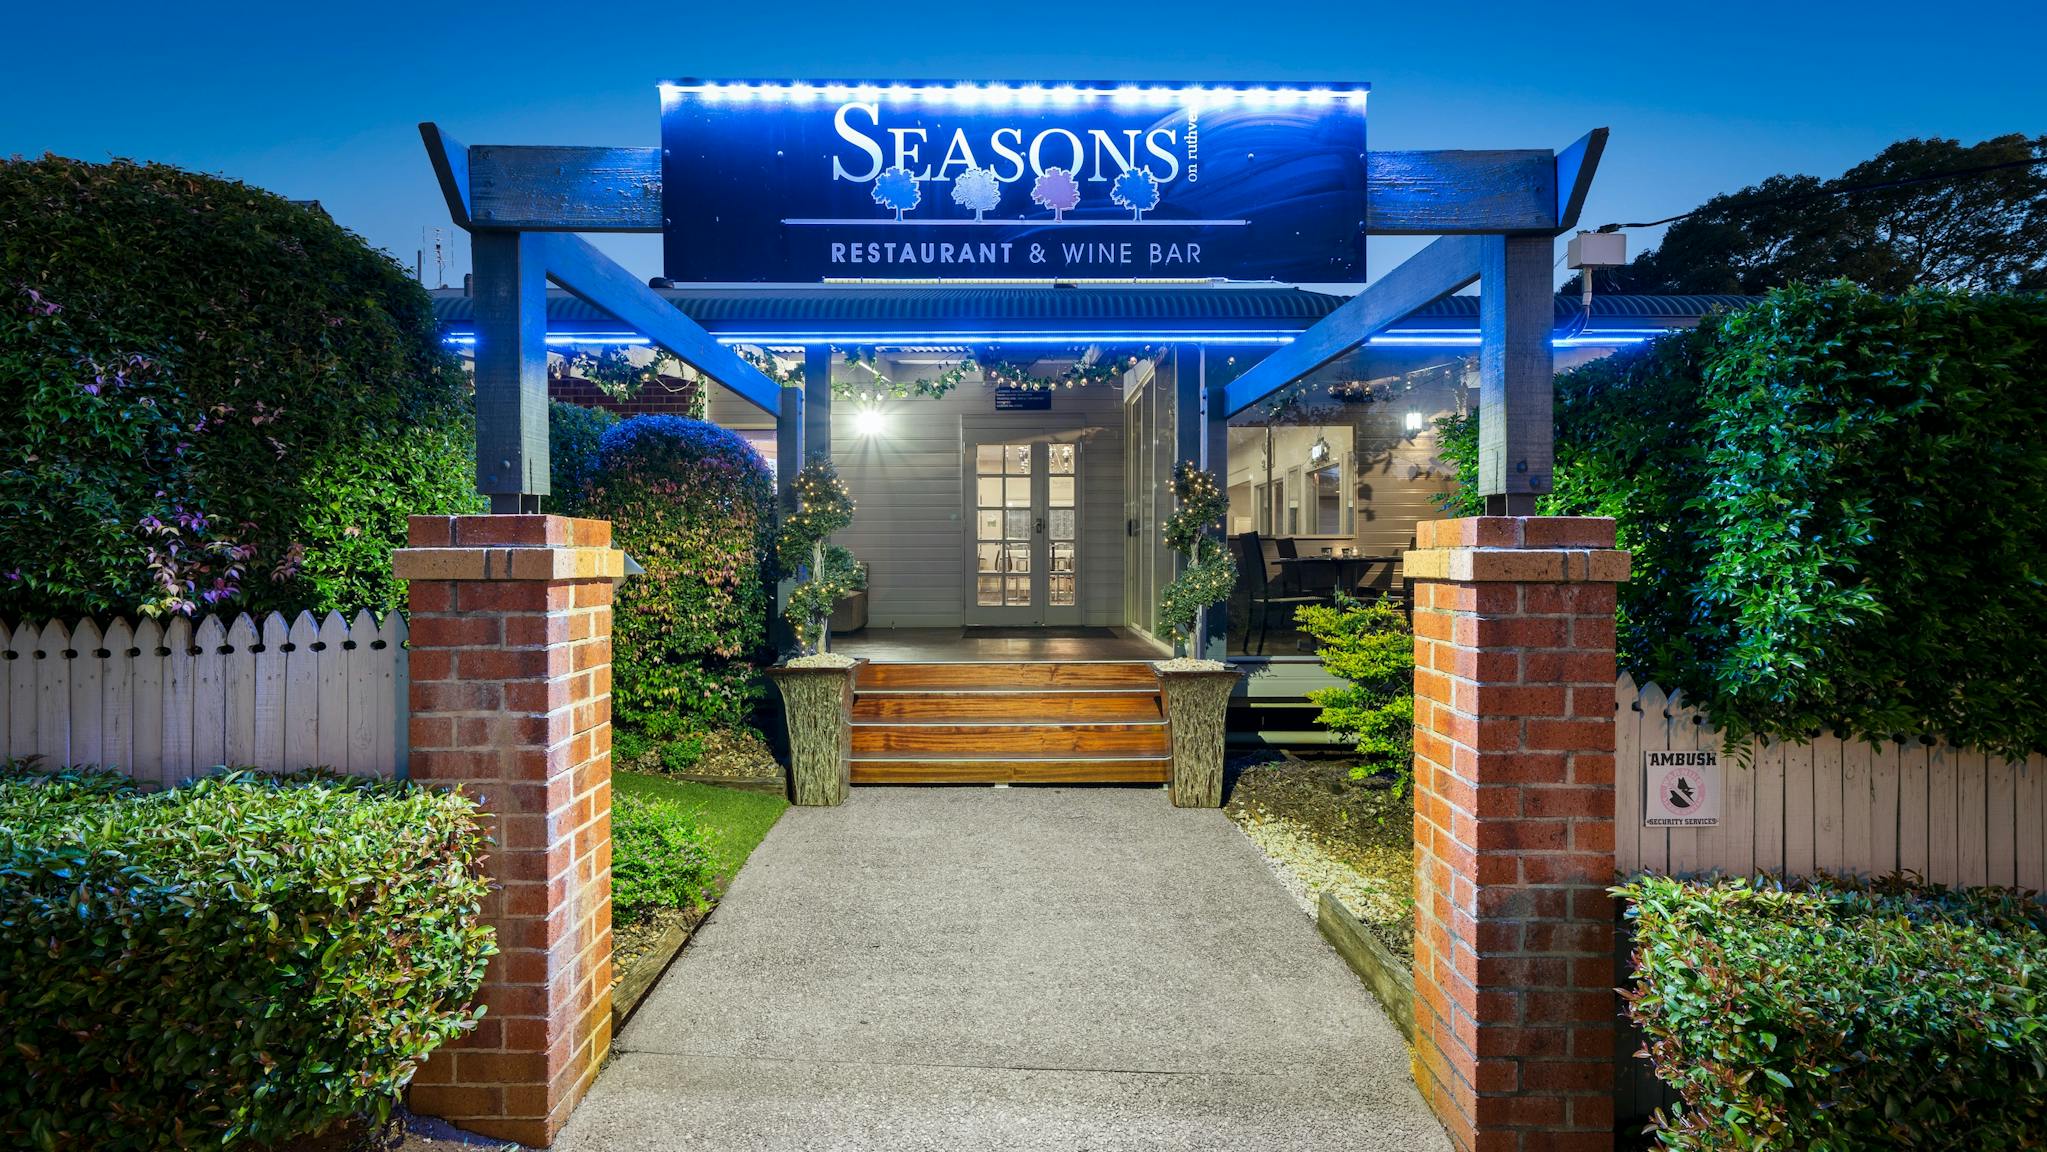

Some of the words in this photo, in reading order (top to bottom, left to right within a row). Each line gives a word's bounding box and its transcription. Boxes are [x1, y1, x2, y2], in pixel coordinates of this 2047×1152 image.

[833, 102, 1179, 183] SEASONS
[1184, 106, 1198, 160] ruthve
[1187, 163, 1198, 183] on
[831, 242, 1014, 264] RESTAURANT
[1029, 242, 1047, 264] &
[1062, 242, 1132, 264] WINE
[1150, 242, 1201, 264] BAR
[1650, 752, 1717, 766] AMBUSH
